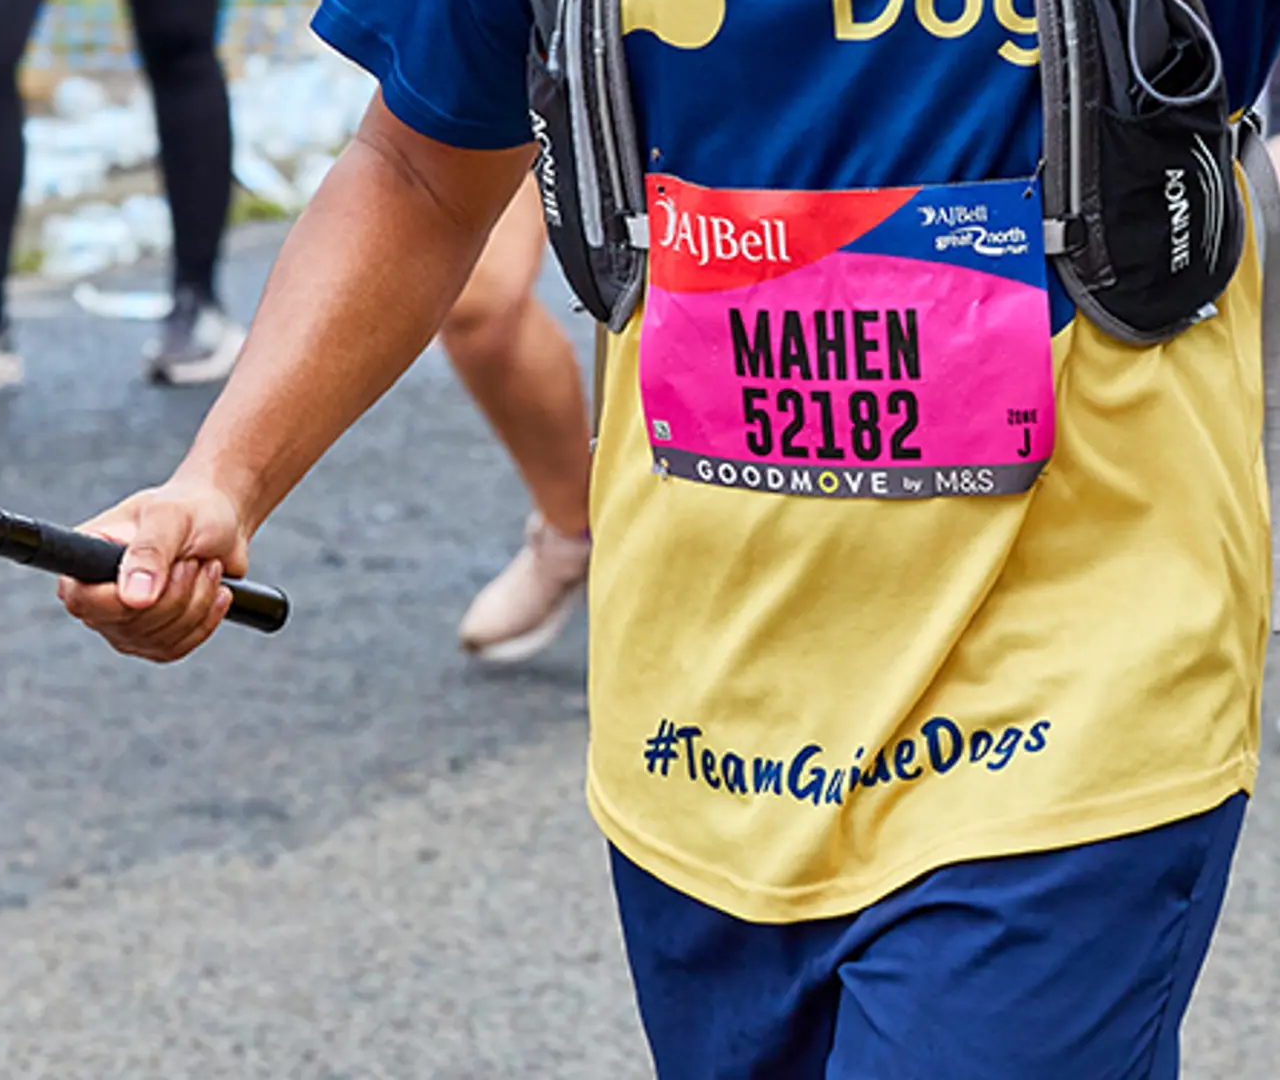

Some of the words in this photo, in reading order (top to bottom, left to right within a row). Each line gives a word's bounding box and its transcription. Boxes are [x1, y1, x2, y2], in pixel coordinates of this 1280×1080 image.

[728, 308, 922, 381] MAHEN
[742, 385, 923, 461] 52182
[1017, 426, 1031, 458] J
[696, 459, 888, 494] GOODMOVE
[901, 474, 923, 491] by
[934, 468, 995, 494] M&S
